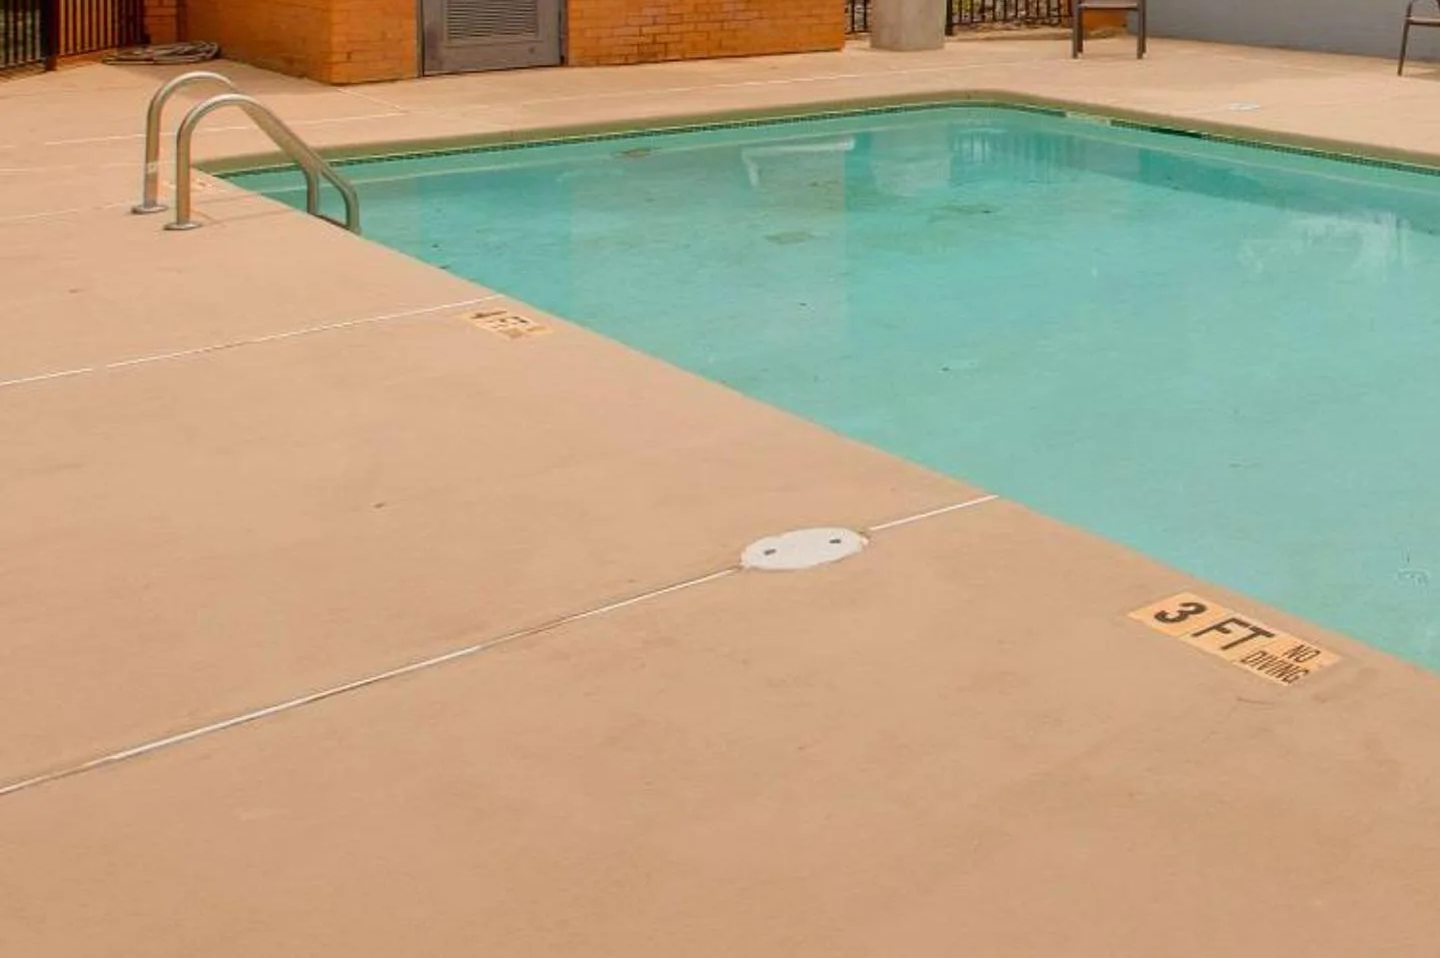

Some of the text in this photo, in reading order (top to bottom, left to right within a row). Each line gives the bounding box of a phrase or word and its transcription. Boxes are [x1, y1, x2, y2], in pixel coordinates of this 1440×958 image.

[1153, 601, 1275, 651] 3 FT
[1240, 650, 1310, 684] DIVING
[1282, 643, 1321, 664] NO
